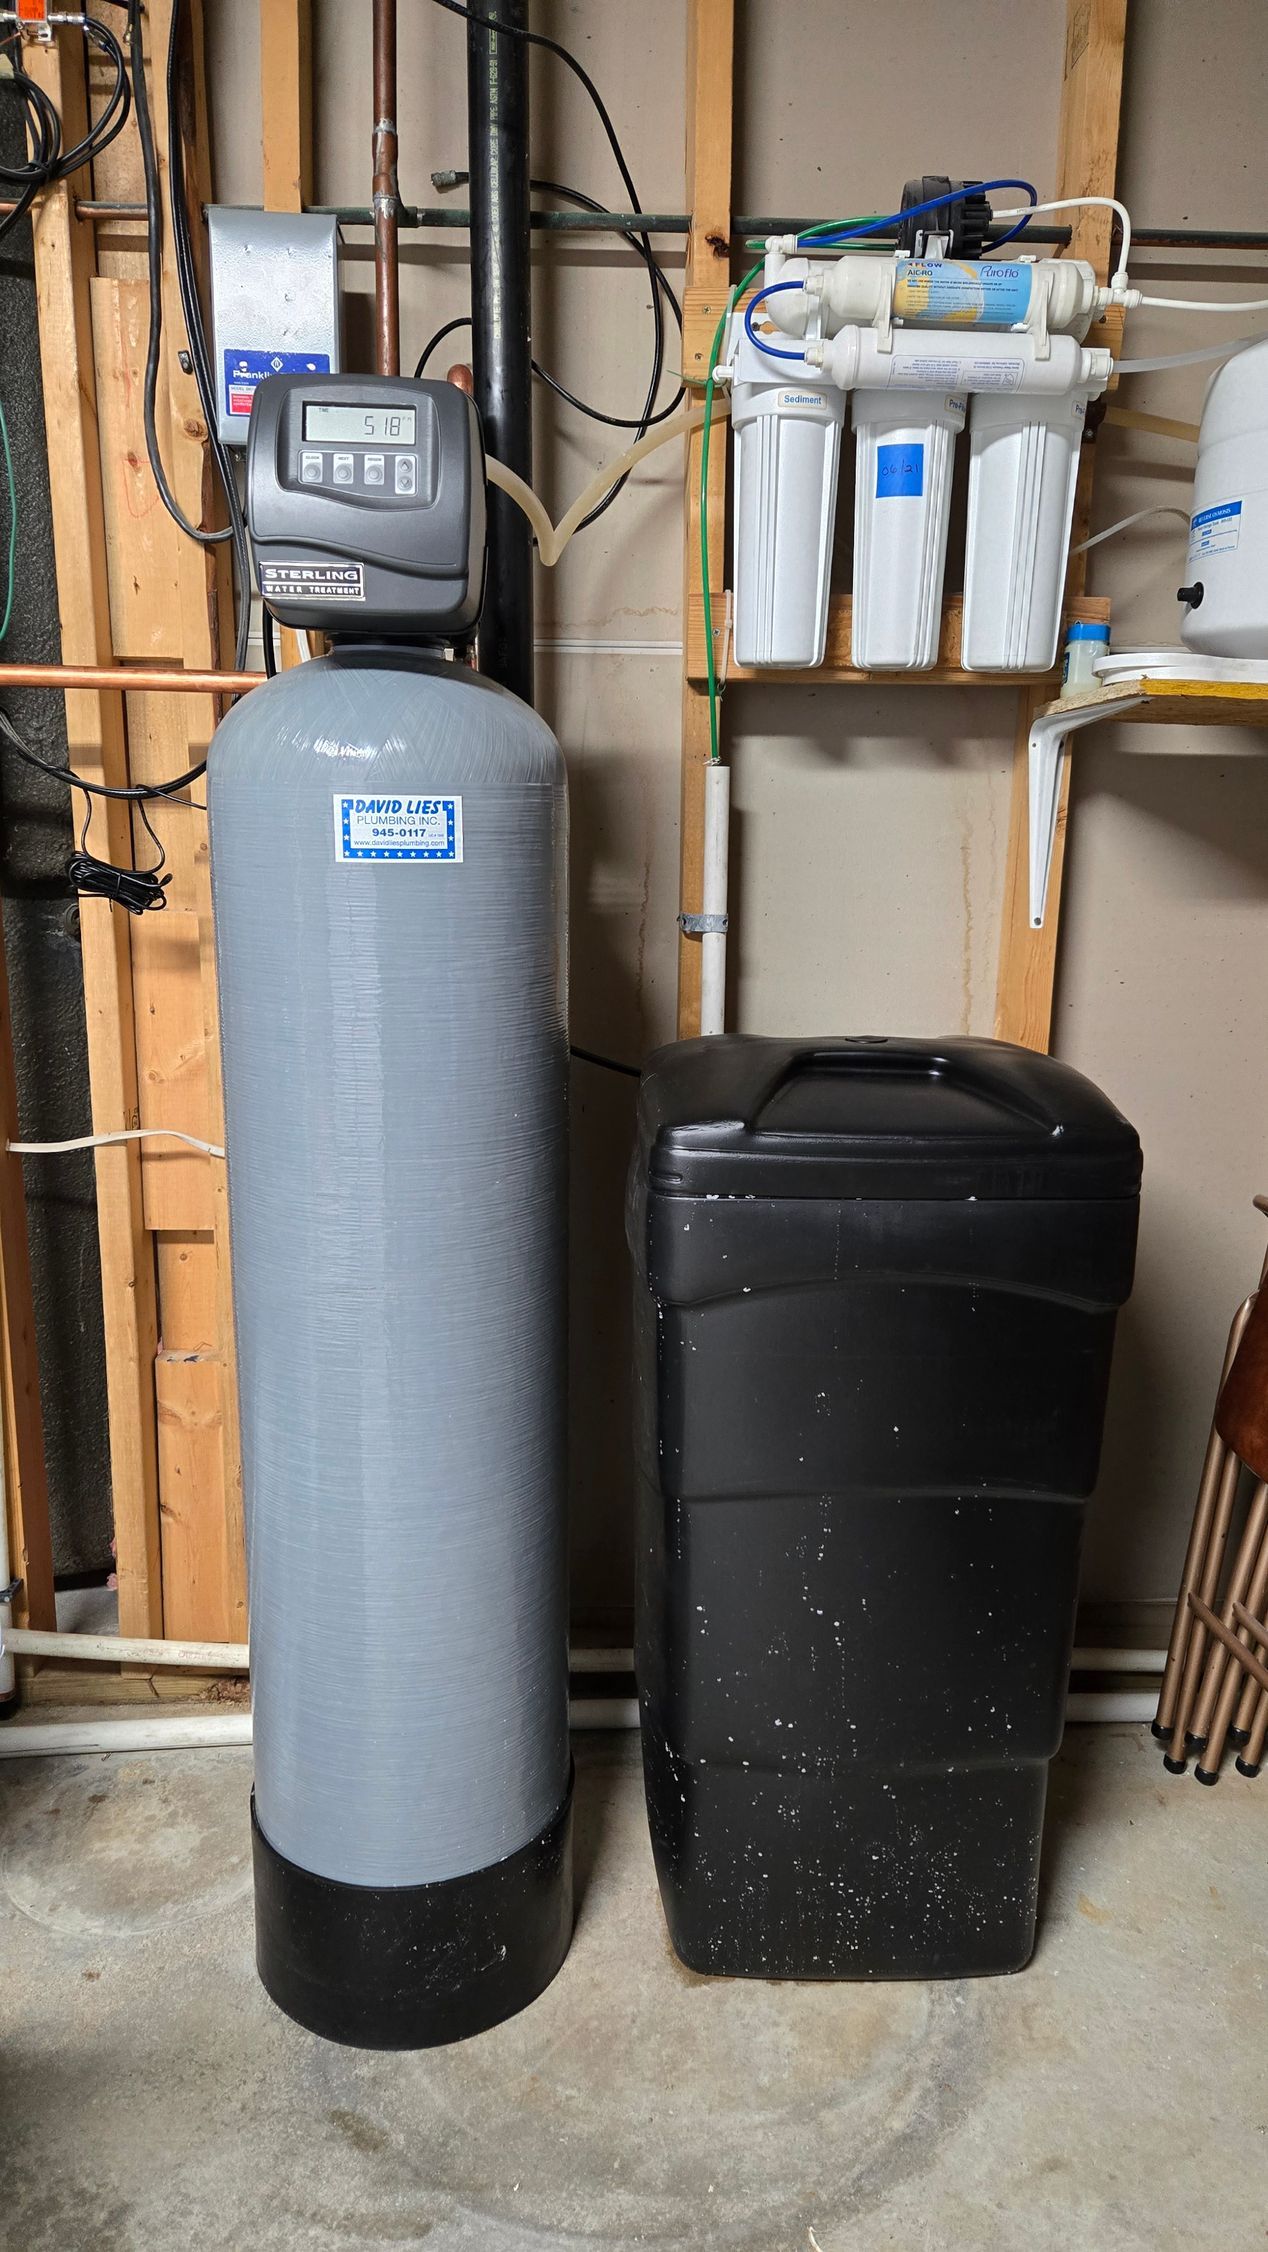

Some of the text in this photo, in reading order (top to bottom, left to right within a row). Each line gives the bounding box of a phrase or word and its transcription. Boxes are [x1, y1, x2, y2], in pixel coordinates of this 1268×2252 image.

[489, 88, 498, 104] ASTM
[489, 107, 498, 120] PIPE
[232, 369, 271, 380] Frankli
[784, 395, 821, 404] Sediment
[881, 459, 919, 476] 06/21
[265, 568, 358, 581] STERLING
[266, 585, 360, 595] WATER TREATMENT
[355, 799, 441, 815] DAVID LIES
[357, 815, 441, 826] PLUMBING INC.
[372, 828, 427, 838] 945-0117
[354, 840, 445, 848] www.davidliesplumbing.com
